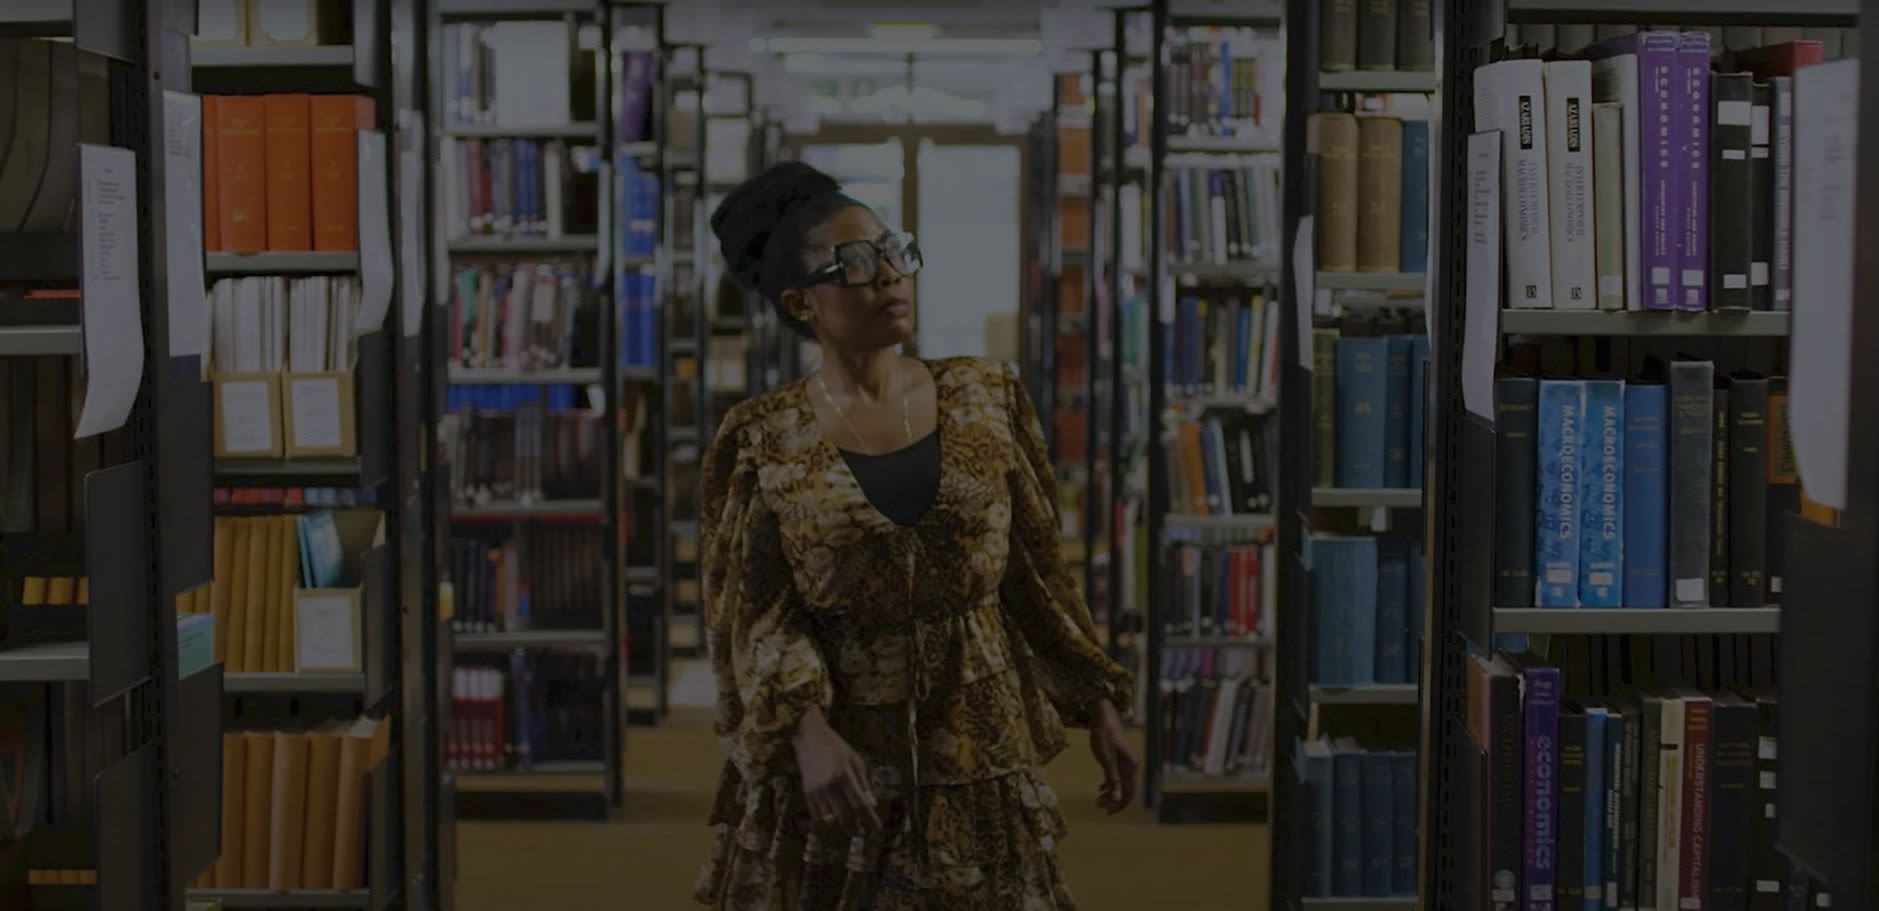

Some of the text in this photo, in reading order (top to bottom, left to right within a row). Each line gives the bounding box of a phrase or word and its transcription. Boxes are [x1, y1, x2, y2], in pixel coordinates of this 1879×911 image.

[1659, 66, 1669, 168] ECONOMICS
[1691, 67, 1701, 169] ECONOMICS
[1559, 404, 1575, 540] MACROECONOMICS
[1602, 405, 1616, 540] MACROECONOMICS
[1536, 735, 1555, 869] economics
[1692, 743, 1705, 833] UNDERSTANDING
